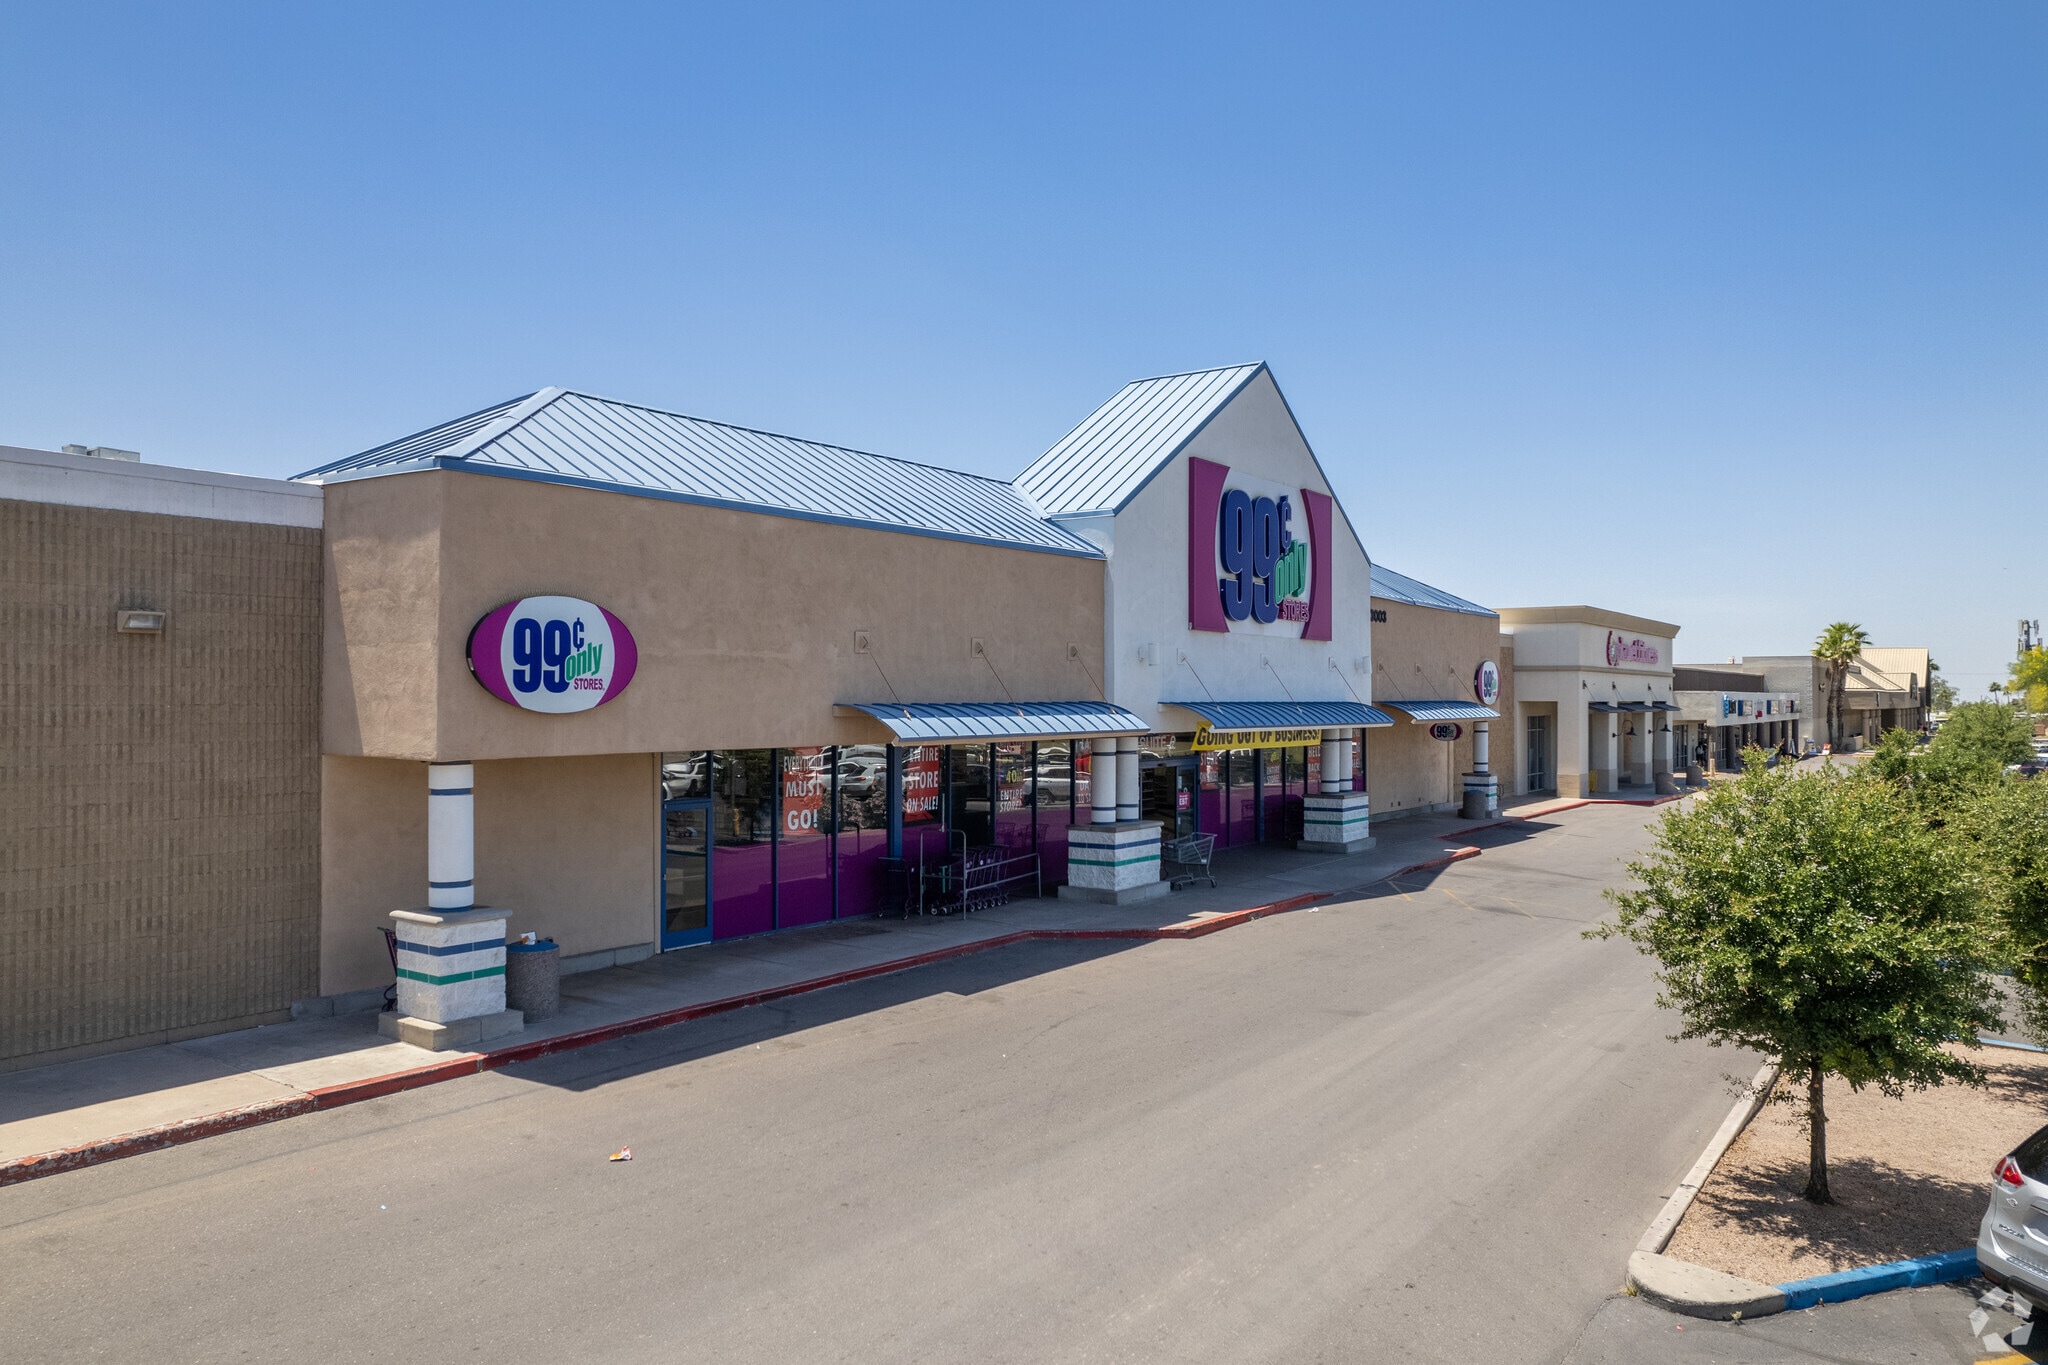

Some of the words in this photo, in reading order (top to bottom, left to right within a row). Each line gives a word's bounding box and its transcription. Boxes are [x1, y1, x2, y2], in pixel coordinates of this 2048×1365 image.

[1274, 539, 1308, 604] only
[1279, 599, 1310, 623] STORES
[565, 642, 603, 681] only
[573, 678, 603, 691] STORES
[1197, 727, 1233, 746] GOING
[1238, 730, 1255, 745] OUT
[1260, 730, 1273, 744] OF
[1275, 729, 1320, 742] BUSINESS!
[909, 747, 939, 762] ENTIRE
[909, 771, 939, 789] STORE
[1006, 769, 1017, 784] 40
[785, 780, 822, 797] MUST
[1000, 789, 1023, 800] ENTIRE
[920, 795, 938, 811] SALE!
[787, 809, 818, 830] GO!
